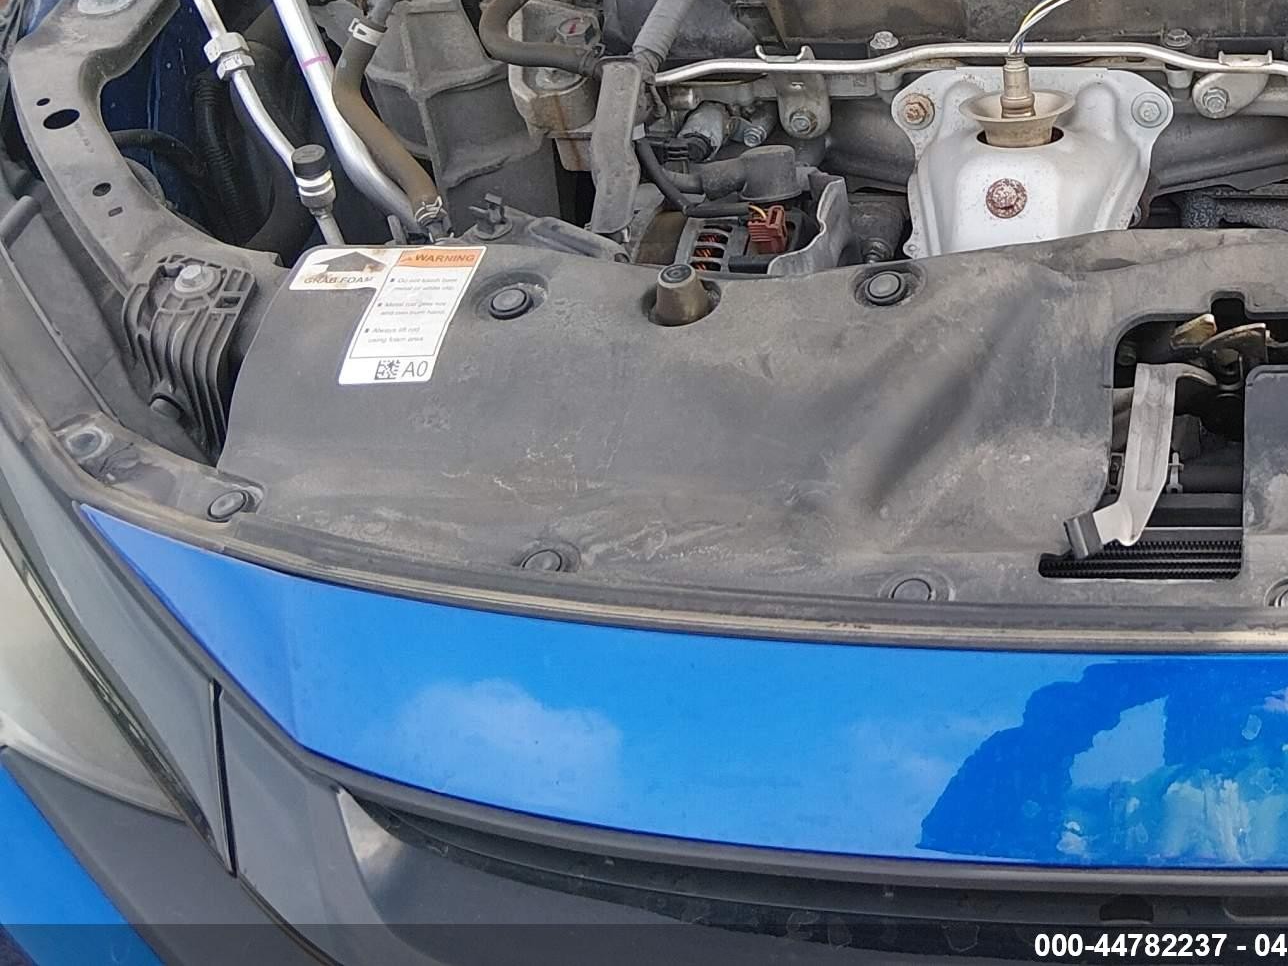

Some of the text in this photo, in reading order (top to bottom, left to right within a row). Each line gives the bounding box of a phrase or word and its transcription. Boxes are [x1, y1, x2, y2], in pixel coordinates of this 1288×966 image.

[415, 254, 475, 262] WARNING
[303, 275, 337, 284] GRAB
[402, 360, 429, 377] A0
